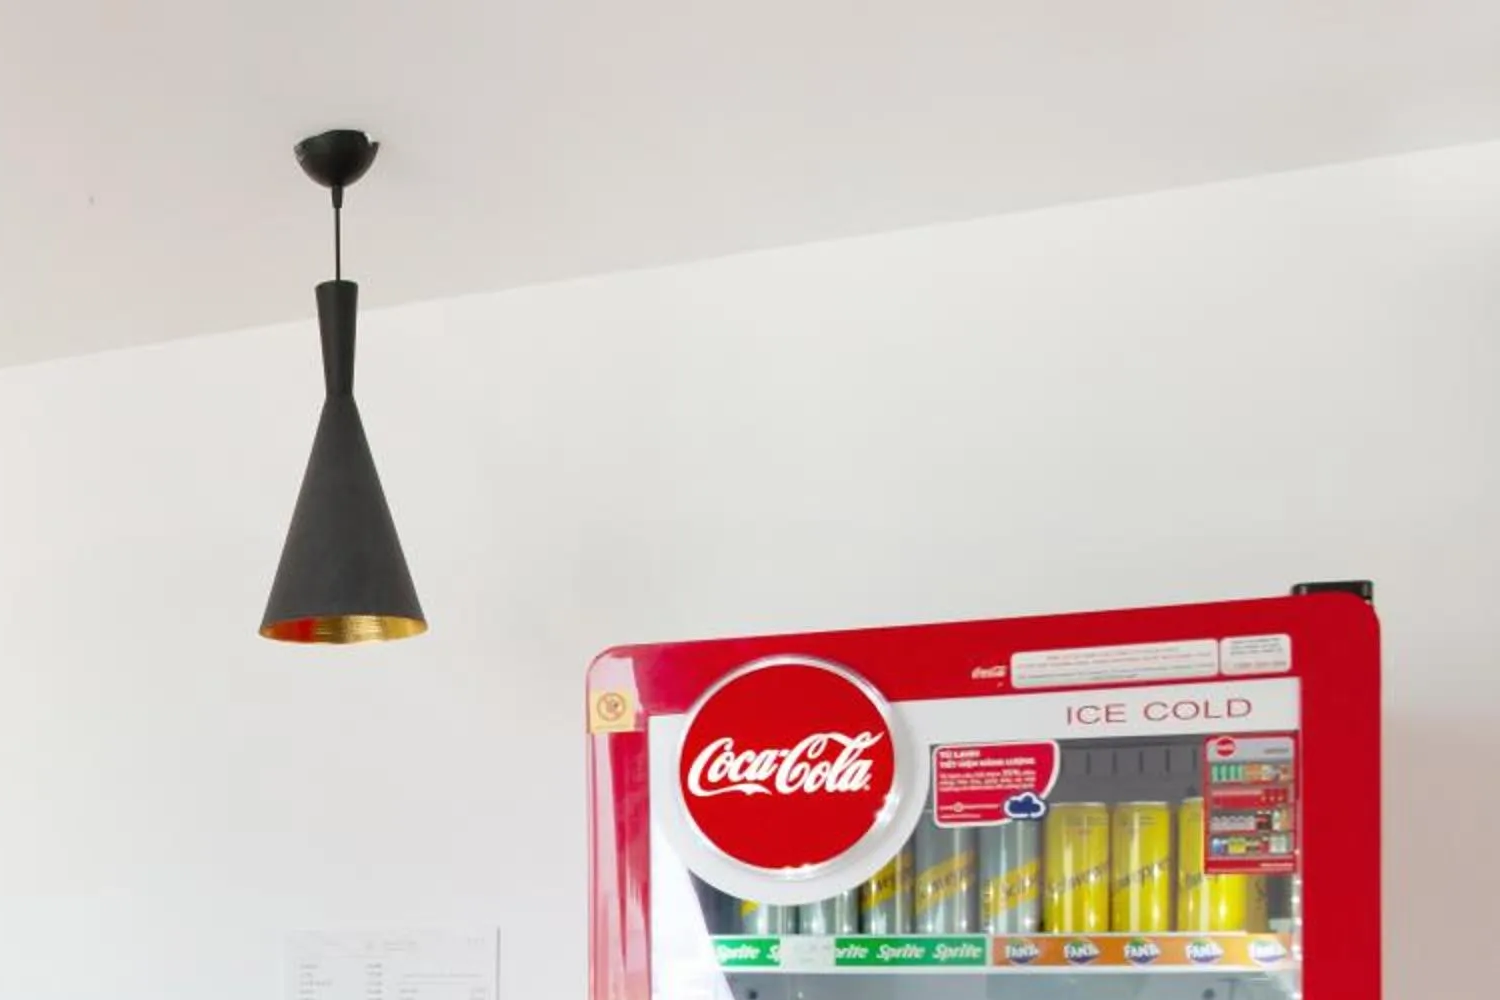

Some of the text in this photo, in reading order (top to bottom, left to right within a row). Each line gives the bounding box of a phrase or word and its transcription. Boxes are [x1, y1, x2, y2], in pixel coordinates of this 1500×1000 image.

[1066, 698, 1252, 725] ICE COLD
[687, 731, 885, 797] Coca-Cola
[876, 943, 926, 961] Sprite
[932, 943, 983, 961] Sprite
